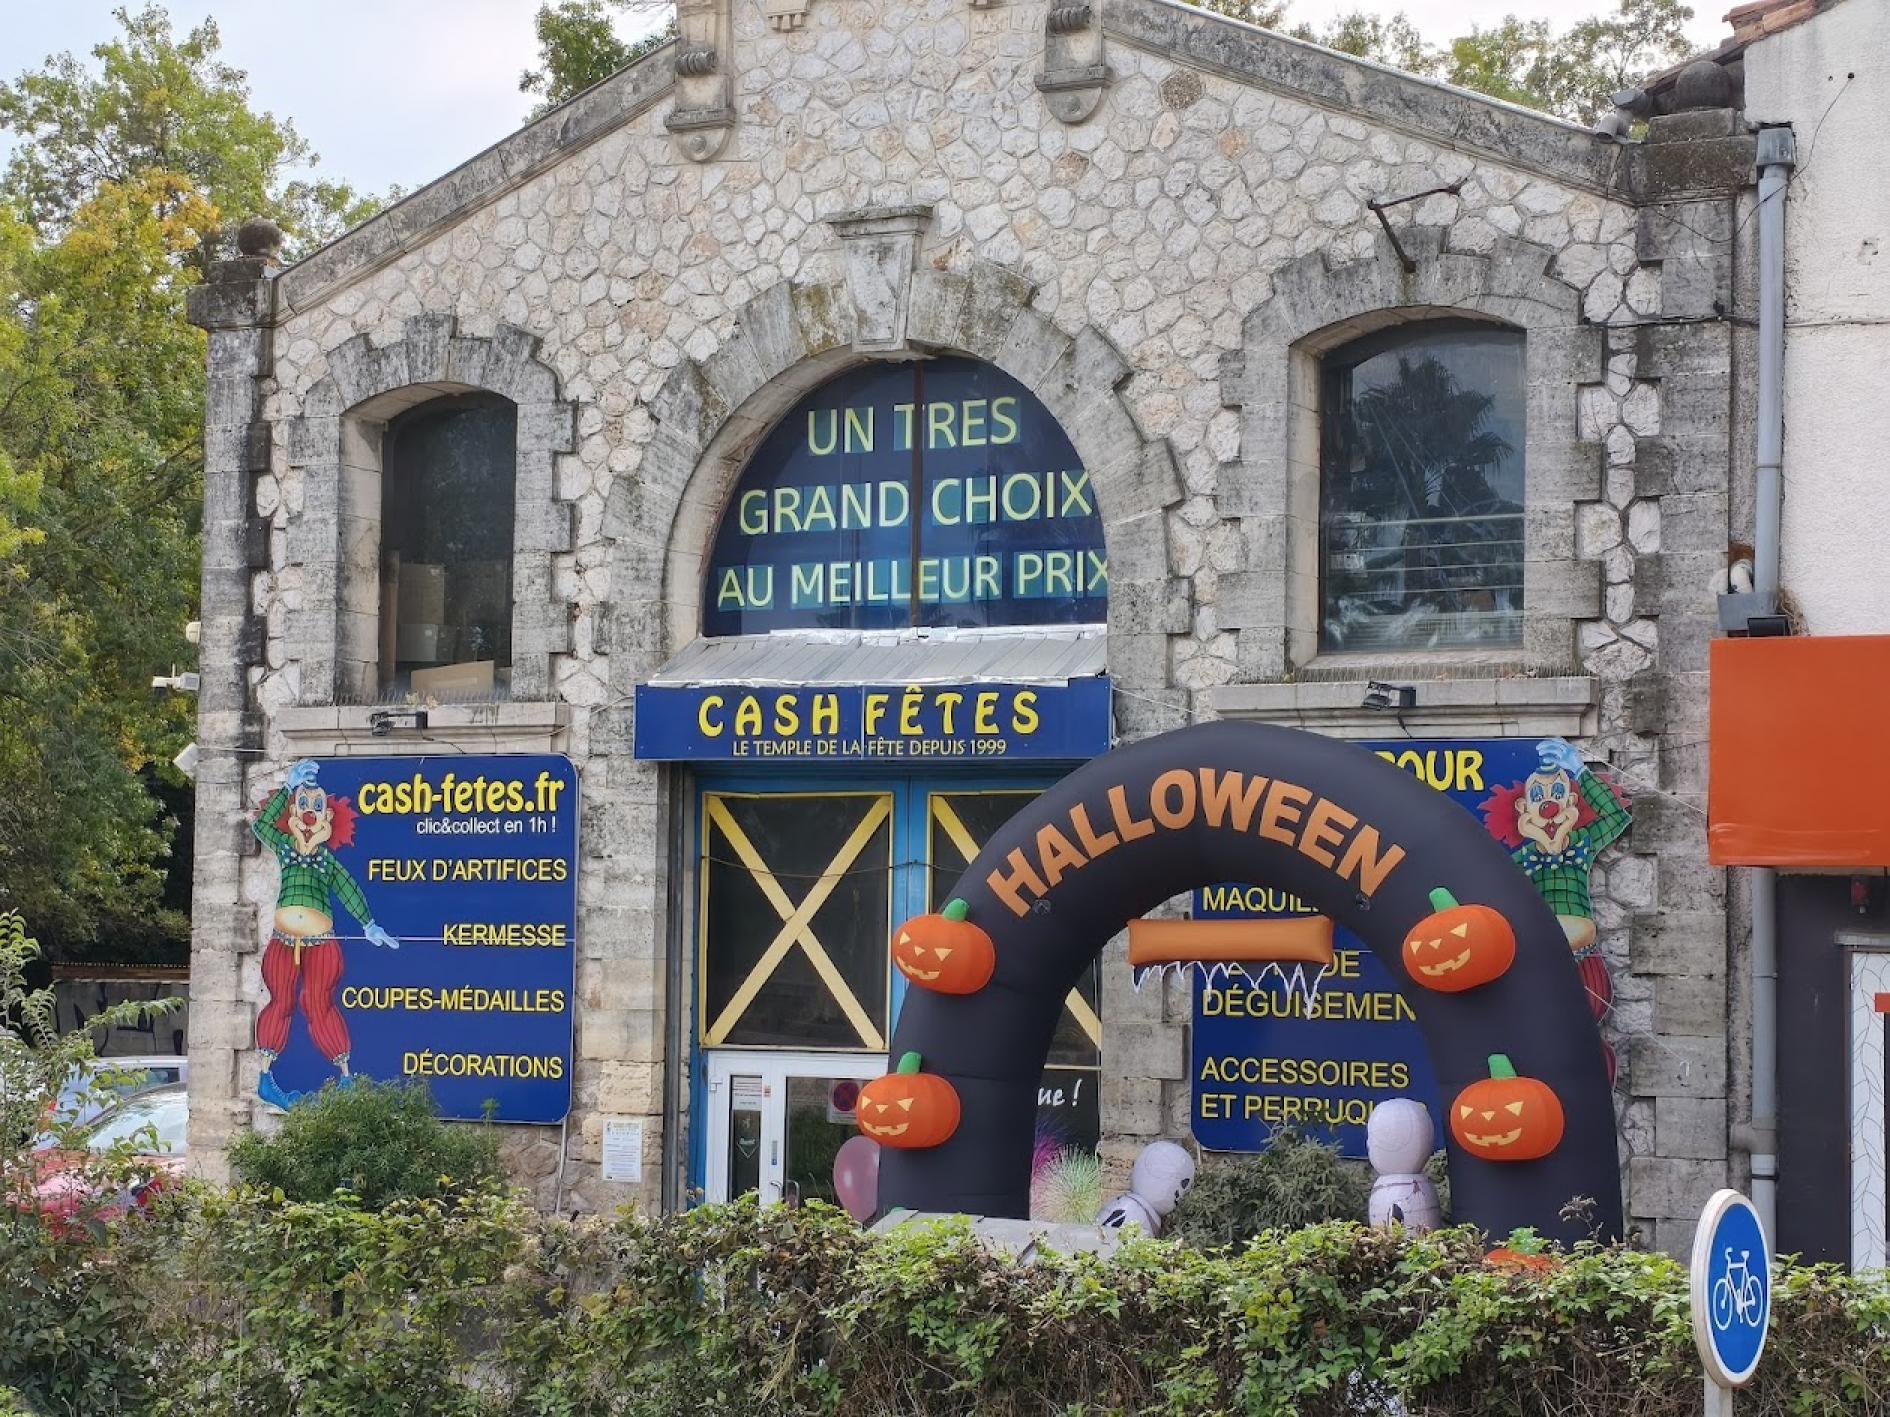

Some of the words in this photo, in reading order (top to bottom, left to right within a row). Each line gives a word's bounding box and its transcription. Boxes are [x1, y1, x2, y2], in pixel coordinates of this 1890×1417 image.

[808, 405, 874, 456] UN
[893, 396, 1018, 449] TRES
[739, 480, 910, 535] GRAND
[931, 470, 1092, 525] CHOIX
[717, 565, 773, 607] AU
[791, 556, 999, 604] MEILLEUR
[1017, 549, 1109, 594] PRIX
[698, 693, 840, 737] CASH
[864, 686, 1040, 736] FÊTES
[733, 740, 749, 756] LE
[753, 740, 812, 756] TEMPLE
[817, 740, 838, 755] DE
[842, 740, 861, 755] LA
[868, 736, 904, 755] FÊTE
[909, 740, 965, 756] DEPUIS
[970, 739, 1007, 755] 1999
[357, 772, 565, 815] cash-fetes.fr
[416, 817, 500, 834] clic&collect
[504, 820, 523, 833] en
[529, 817, 547, 832] 1h
[551, 817, 556, 832] !
[986, 767, 1406, 918] HALLOWEEN
[368, 859, 426, 881] FEUX
[432, 858, 567, 882] D'ARTIFICES
[1202, 886, 1319, 912] MAQUIL
[443, 924, 566, 947] KERMESSE
[341, 985, 564, 1012] COUPES-MÉDAILLES
[1202, 983, 1416, 1021] DÉGUISEMEN
[403, 1049, 563, 1078] DÉCORATIONS
[1201, 1056, 1409, 1088] ACCESSOIRES
[1037, 1087, 1066, 1107] ue
[1201, 1094, 1237, 1118] ET
[1244, 1096, 1426, 1125] PERRUQ
